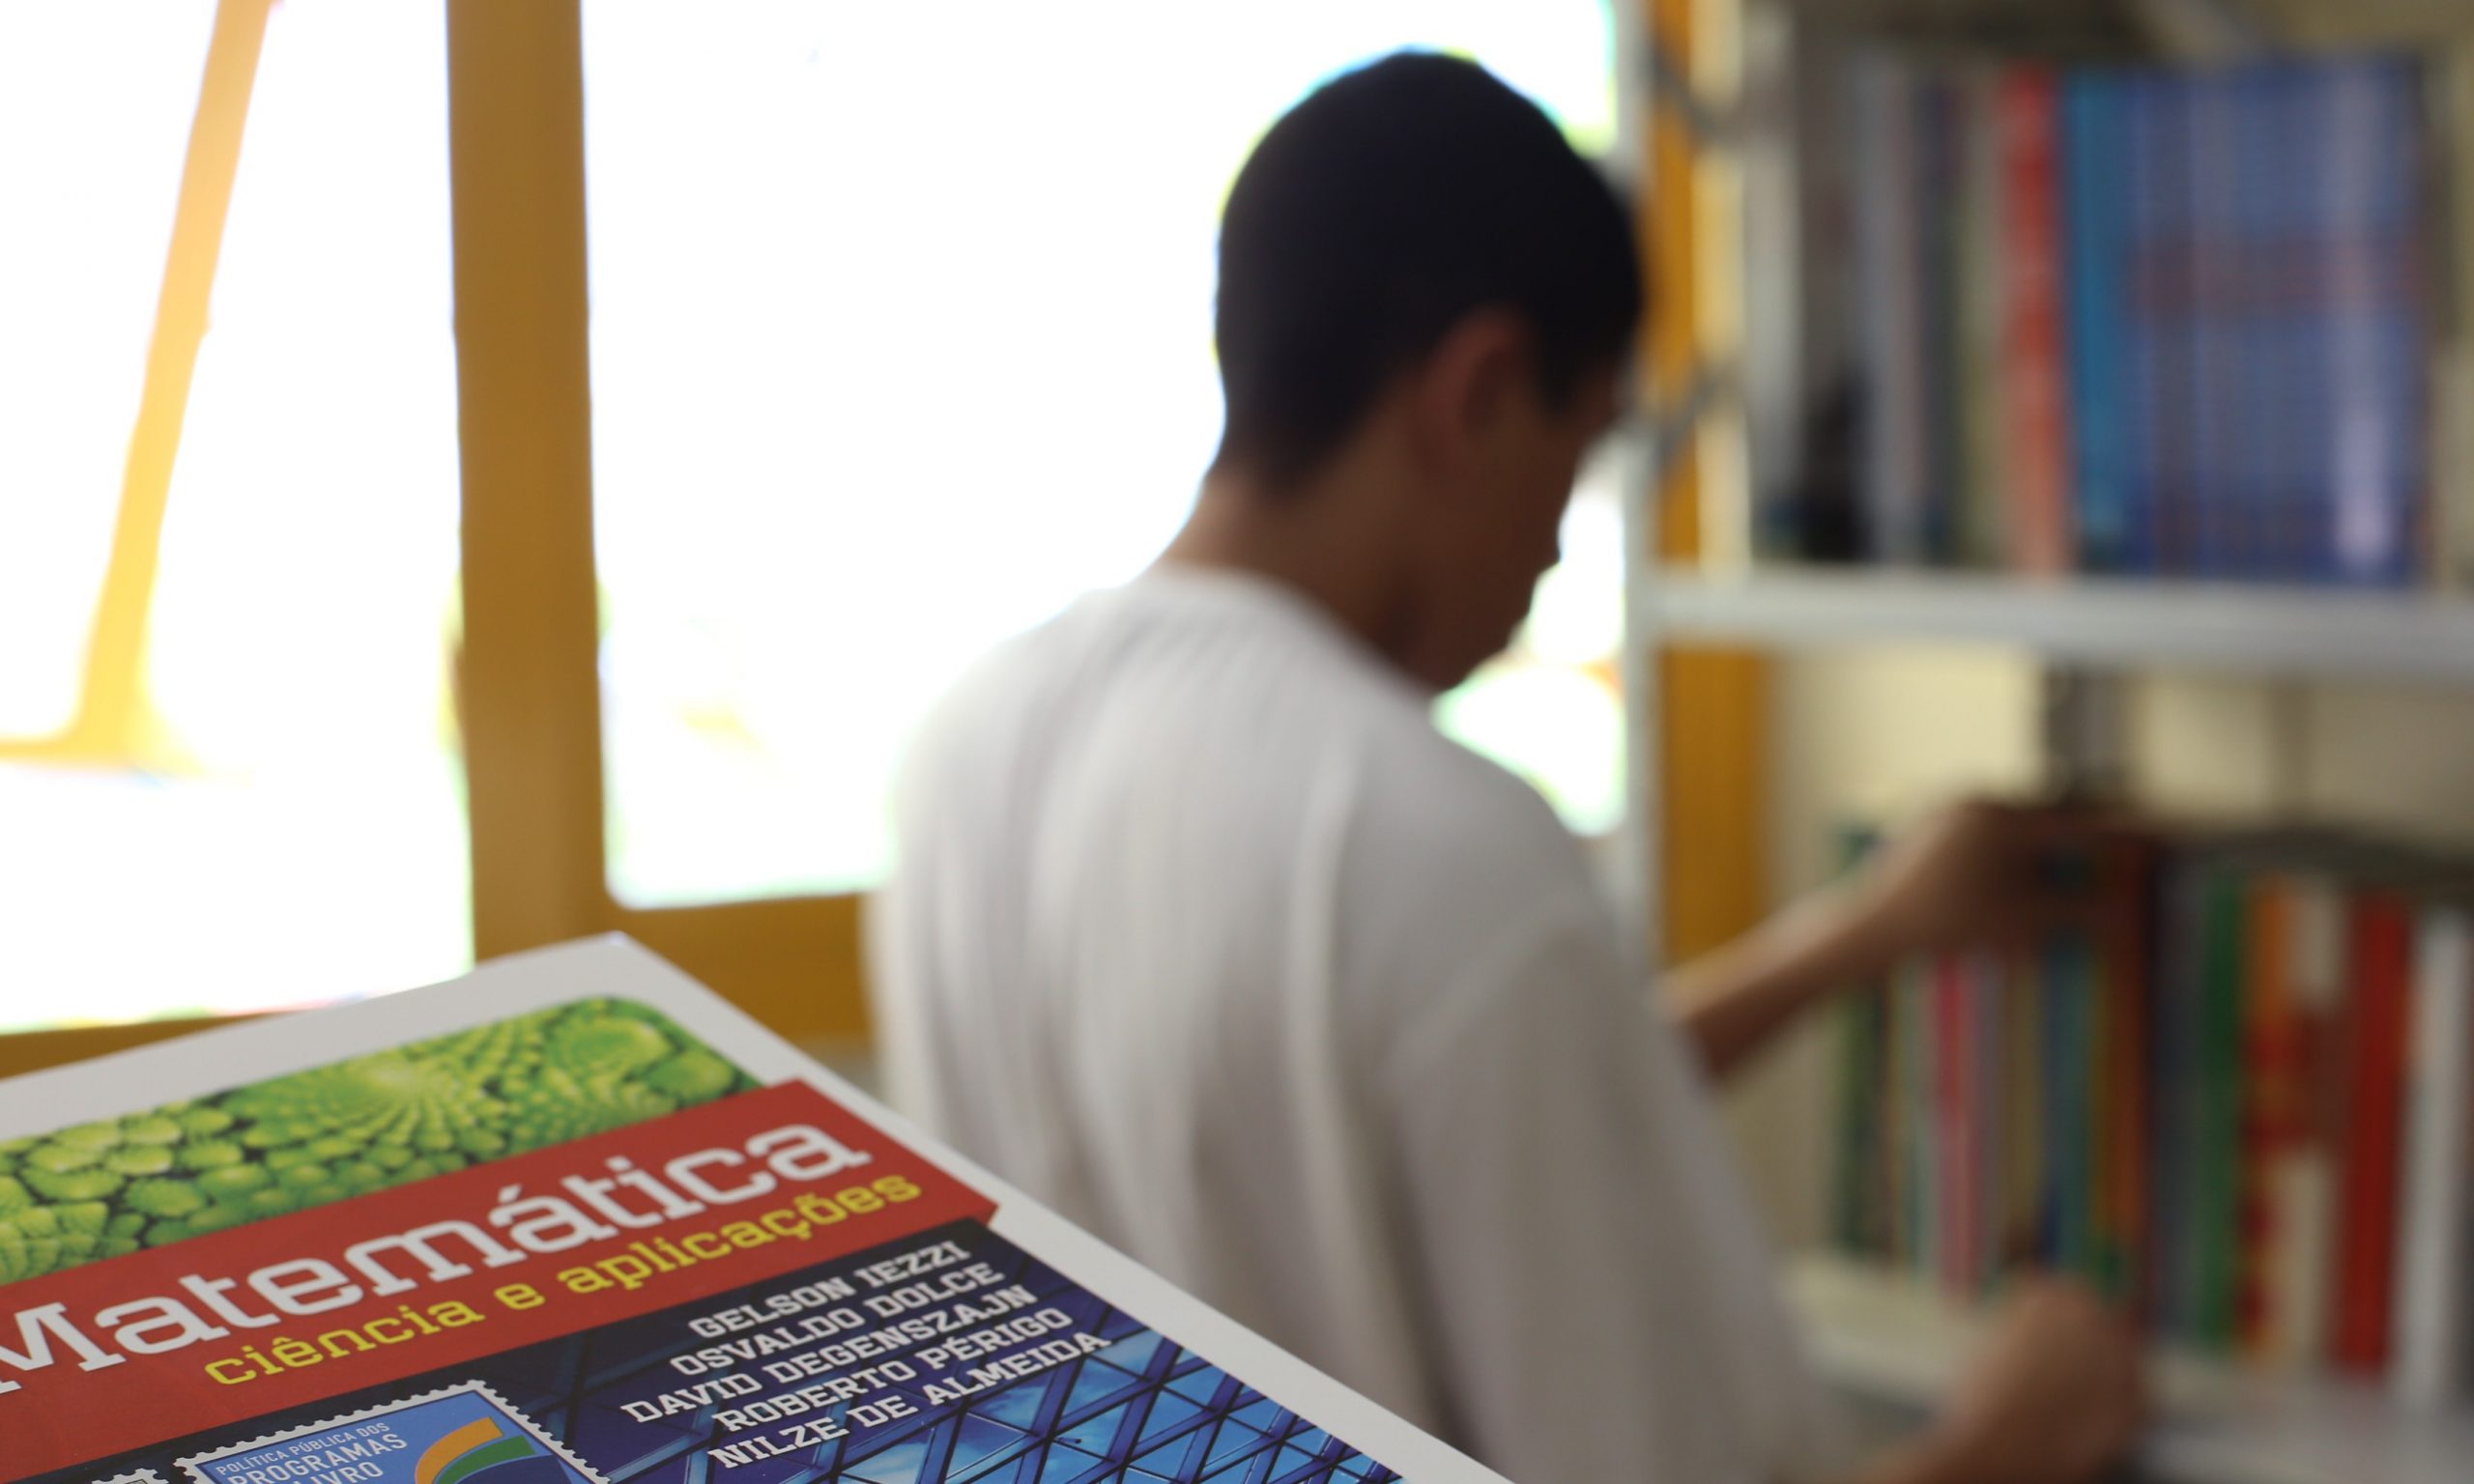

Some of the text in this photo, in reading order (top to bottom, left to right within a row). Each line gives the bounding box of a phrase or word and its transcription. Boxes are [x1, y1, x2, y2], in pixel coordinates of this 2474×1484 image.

[0, 1124, 874, 1394] Matemática
[204, 1174, 922, 1385] ciência e aplicações
[687, 1240, 971, 1338] GELSON IEZZI
[620, 1284, 1039, 1423] DAVID DEGENSZAJN
[670, 1262, 1005, 1376] OSVALDO DOLCE
[711, 1307, 1074, 1432] ROBERTO PÉRIGO
[216, 1422, 390, 1475] POLÍTICA PÚBLICA DOS
[227, 1434, 408, 1484] PROGRAMAS
[707, 1331, 1112, 1469] NILZE DE ALMEIDA
[294, 1461, 384, 1484] IVRO
